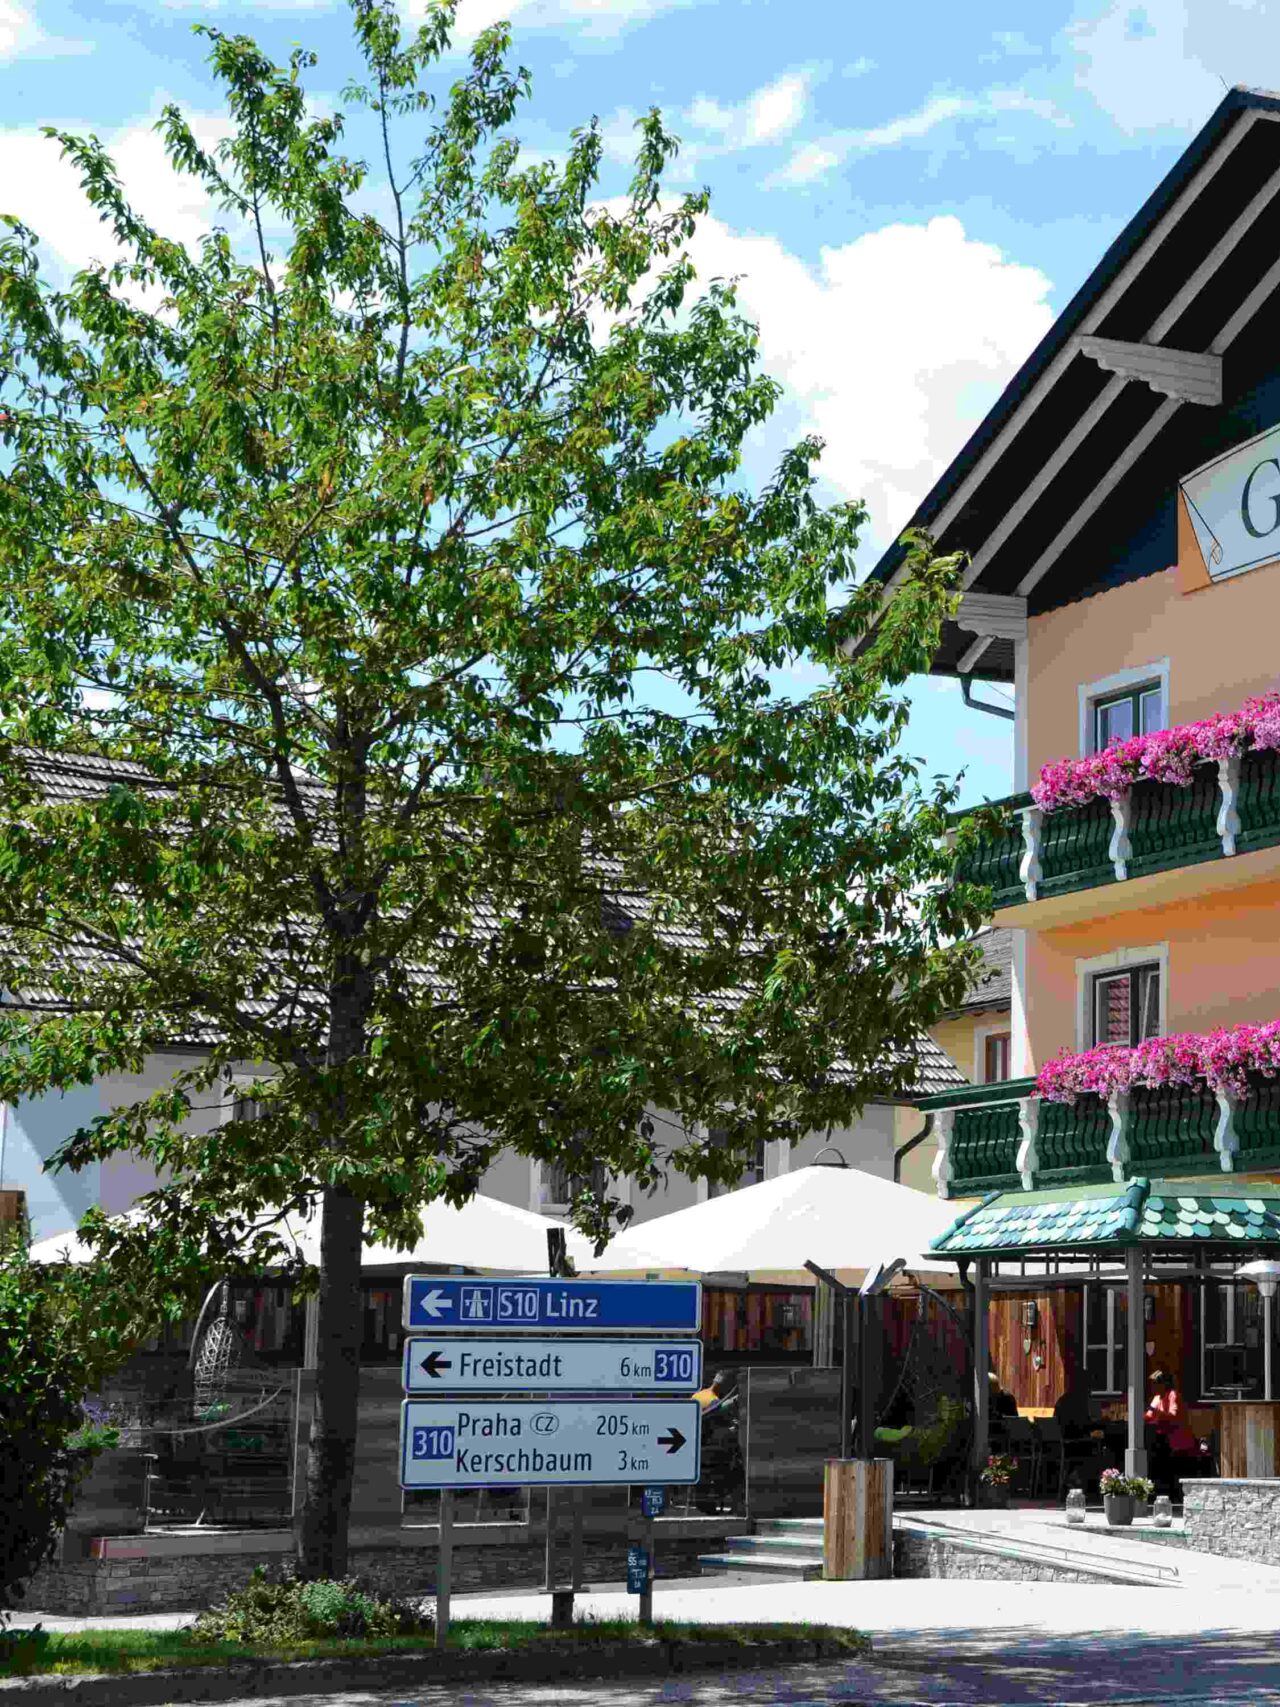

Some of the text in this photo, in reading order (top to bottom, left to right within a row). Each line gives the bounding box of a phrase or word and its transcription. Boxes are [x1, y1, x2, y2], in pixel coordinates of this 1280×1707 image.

[500, 1291, 598, 1318] S10 Linz
[460, 1352, 692, 1379] Freistadt 6 km 310
[458, 1413, 650, 1437] Praha CZ 205 km
[414, 1430, 453, 1455] 310
[456, 1449, 649, 1473] Kerschbaum 3 km
